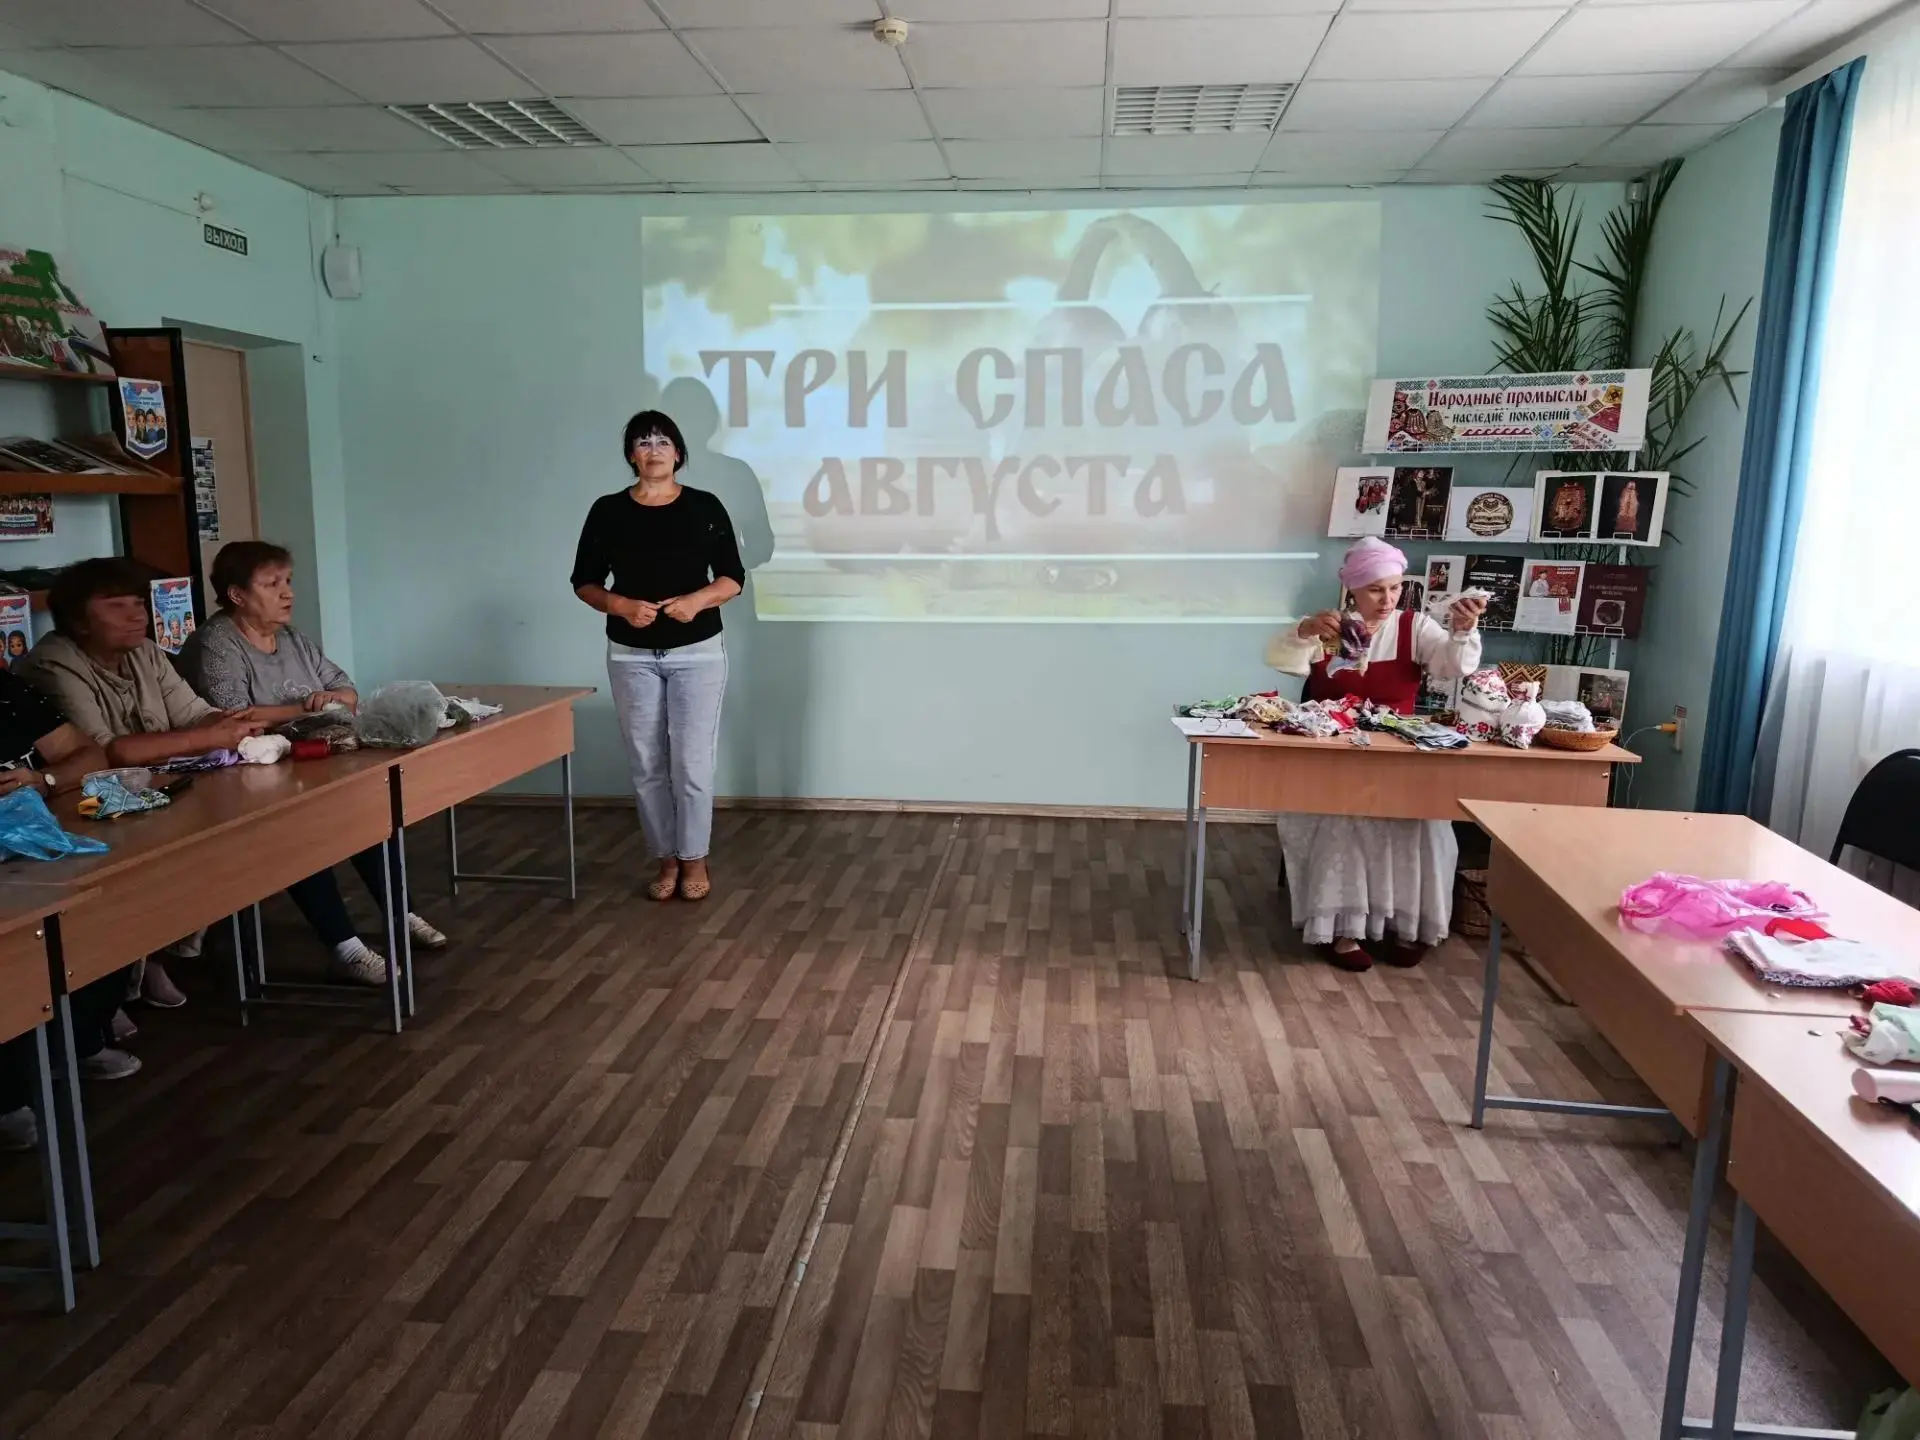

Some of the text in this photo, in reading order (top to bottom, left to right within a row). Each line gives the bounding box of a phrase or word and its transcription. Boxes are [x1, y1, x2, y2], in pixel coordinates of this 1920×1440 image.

[205, 226, 245, 252] ВЫХОД
[698, 341, 1297, 430] ТРИ СПАСА
[1428, 389, 1588, 410] Народные промыслы
[1452, 412, 1504, 424] наследие
[1509, 408, 1570, 423] поколений
[802, 453, 1189, 541] АВГУСТА
